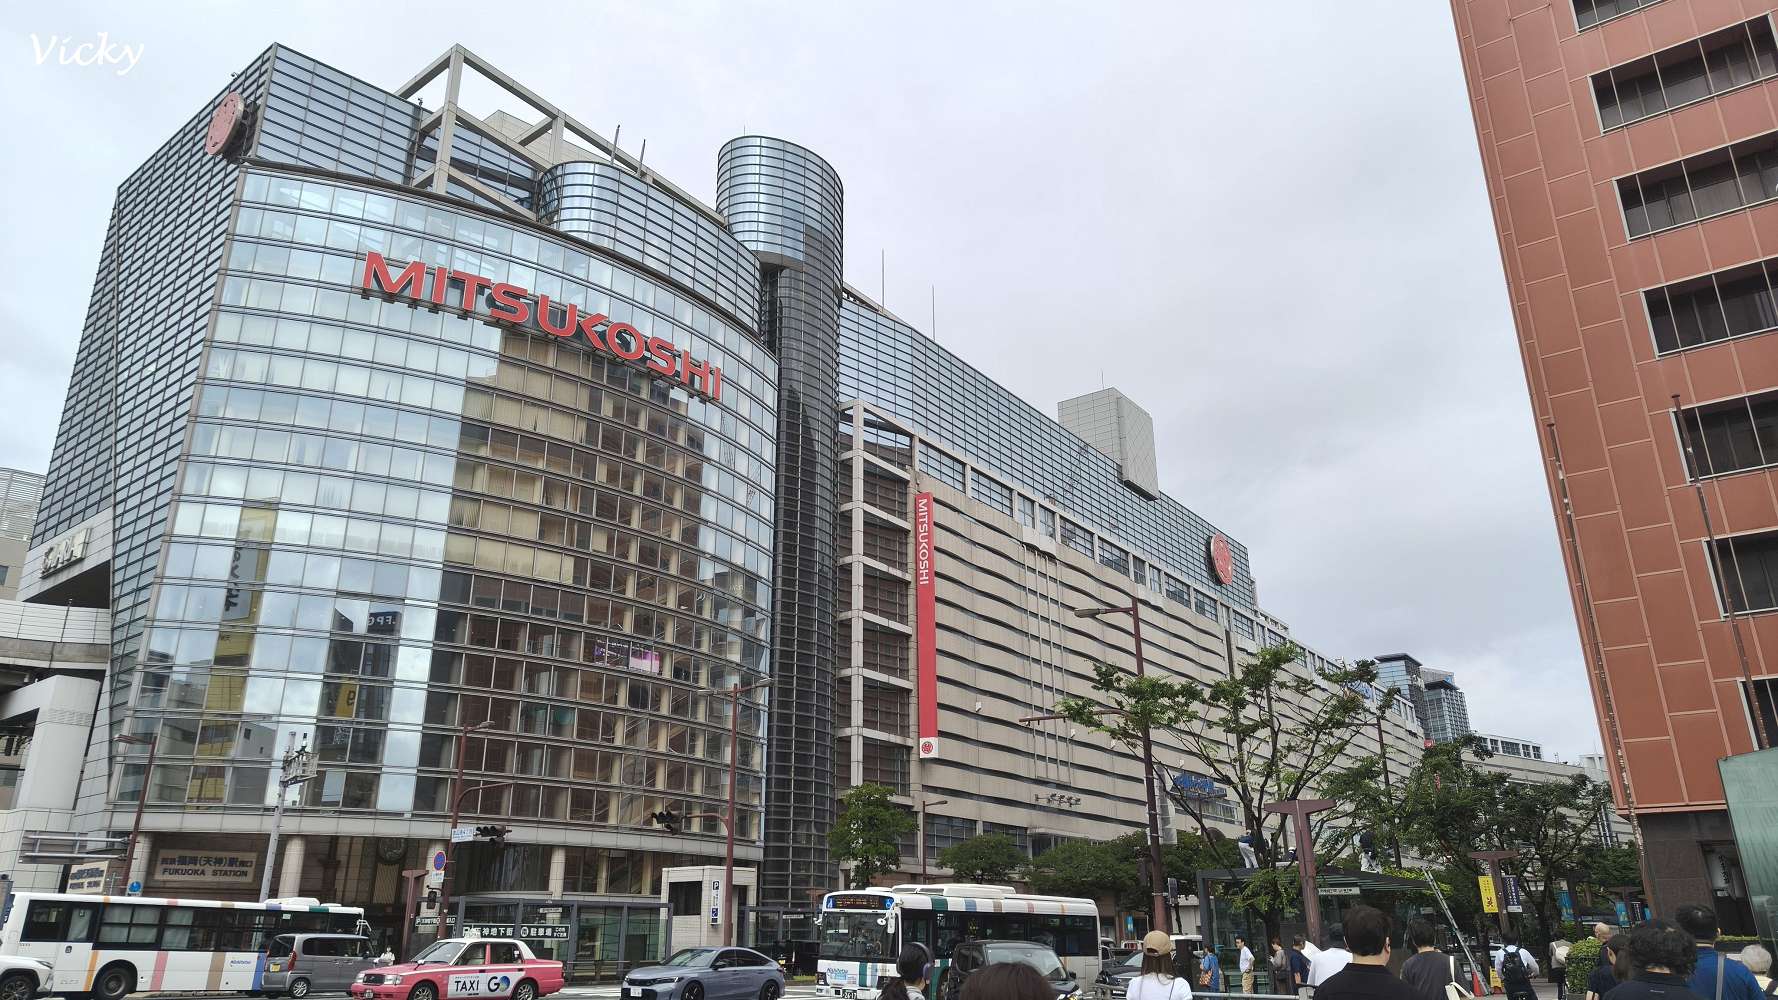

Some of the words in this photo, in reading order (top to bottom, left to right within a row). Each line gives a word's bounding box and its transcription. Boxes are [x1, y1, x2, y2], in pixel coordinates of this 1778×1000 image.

[362, 251, 722, 401] MITSUKOSHI
[918, 498, 929, 585] MITSUKOSHI
[162, 868, 205, 876] FUKUOKA
[212, 869, 248, 877] STATION
[455, 980, 479, 991] TAXI
